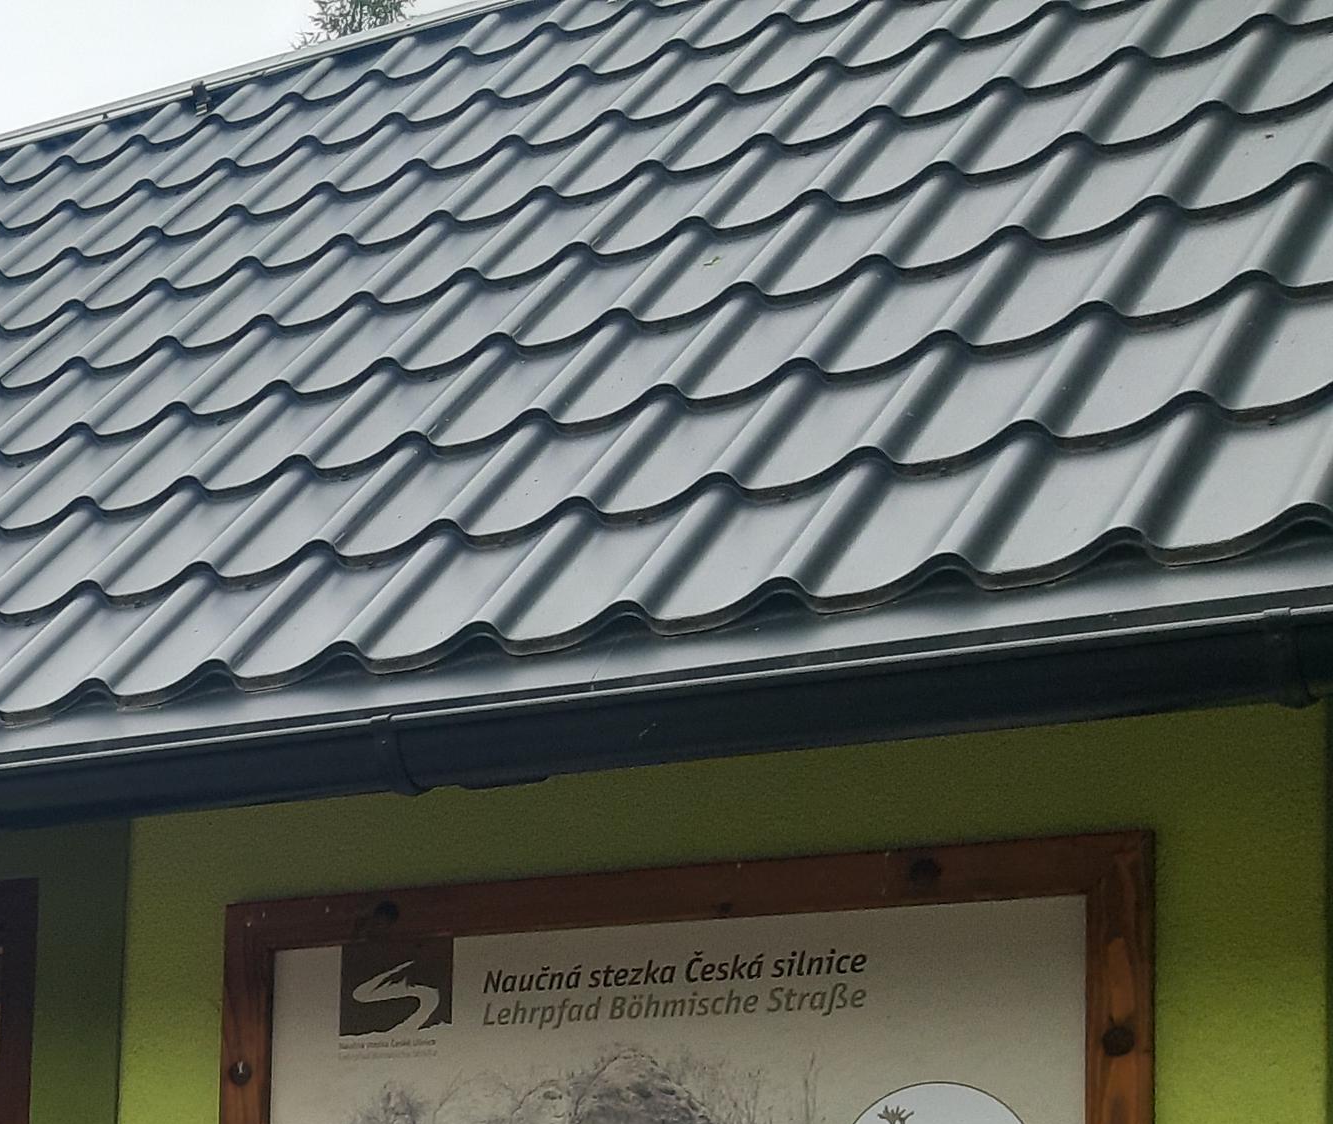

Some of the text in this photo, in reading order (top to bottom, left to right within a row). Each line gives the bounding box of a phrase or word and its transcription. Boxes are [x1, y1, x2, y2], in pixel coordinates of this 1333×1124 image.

[482, 948, 868, 994] Naučná stezka Česká silnice
[482, 982, 868, 1031] Lehrpfad Böhmische Straße
